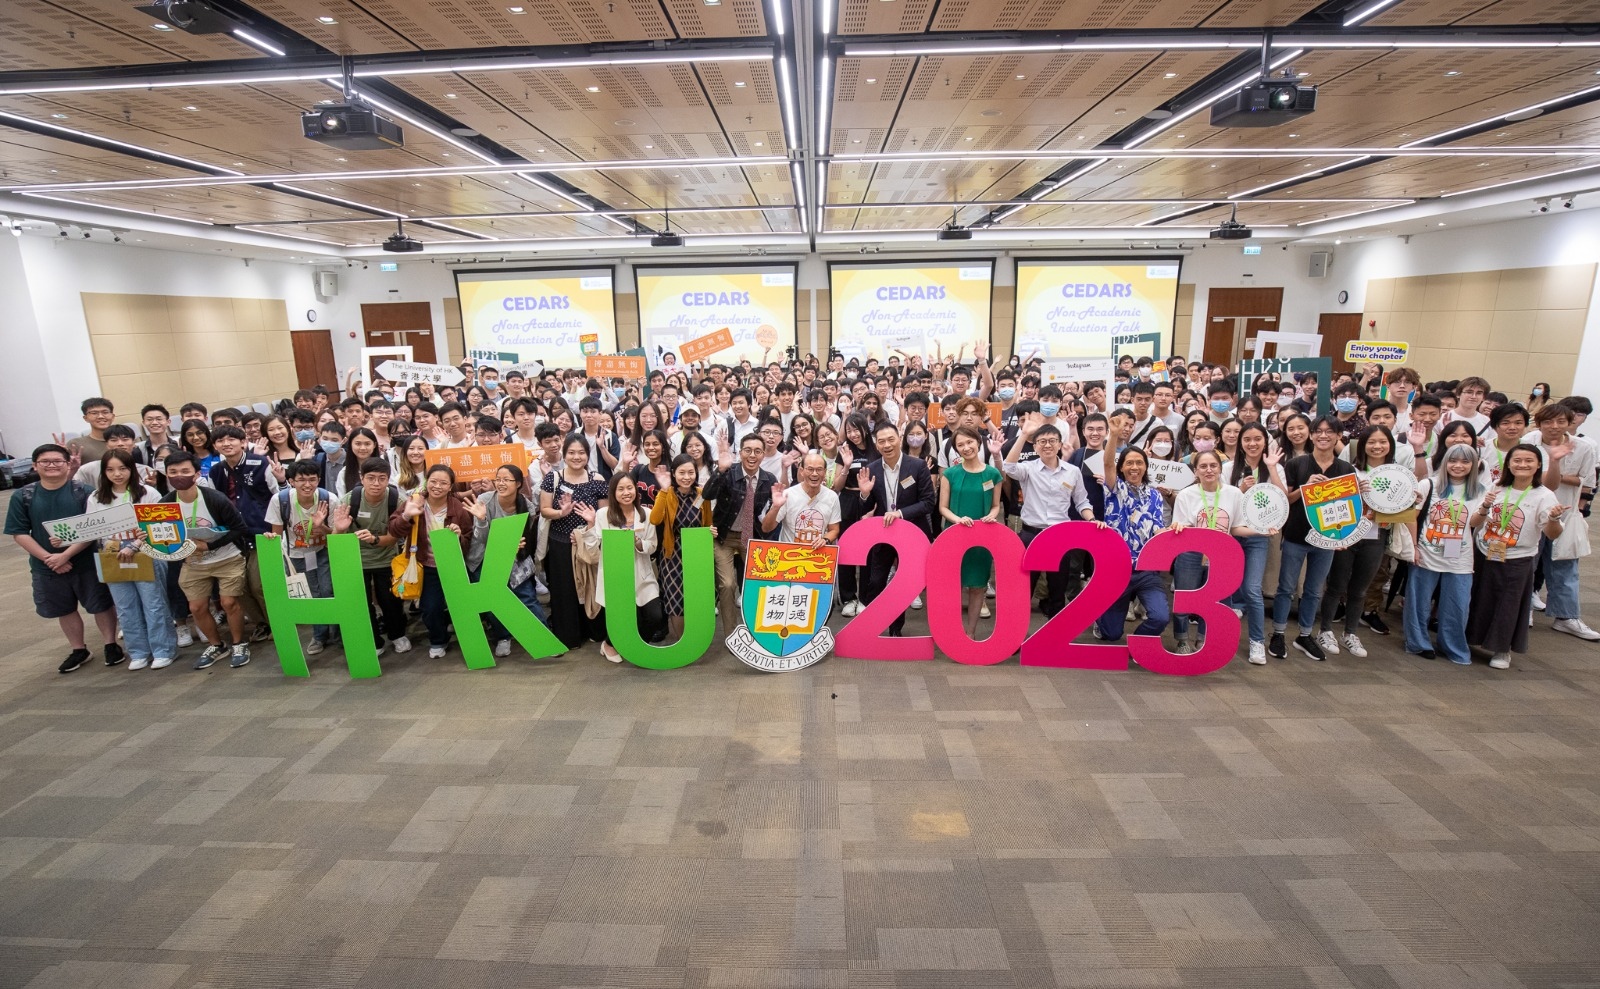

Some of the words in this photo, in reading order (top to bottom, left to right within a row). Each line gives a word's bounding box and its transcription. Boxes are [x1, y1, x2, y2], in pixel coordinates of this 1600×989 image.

[876, 285, 946, 300] CEDARS
[1062, 283, 1132, 298] CEDARS
[503, 295, 570, 311] CEDARS
[682, 291, 750, 306] CEDARS
[669, 313, 761, 328] Non-Academic
[862, 308, 957, 323] Non-Academic
[1046, 306, 1142, 320] Non-Academic
[491, 318, 583, 333] Non-Academic
[866, 324, 924, 336] Induction
[927, 323, 958, 337] Talk
[1050, 321, 1108, 333] Induction
[1110, 321, 1142, 335] Talk
[497, 334, 552, 345] Induction
[555, 332, 580, 347] Tal
[734, 328, 758, 343] Tal
[1350, 344, 1375, 353] Enjoy
[1368, 352, 1404, 360] chapter
[391, 362, 402, 370] The
[405, 364, 435, 375] University
[400, 371, 442, 383] 香港大學
[1161, 463, 1170, 471] of
[1171, 465, 1183, 473] HK
[255, 512, 716, 679] HKU
[834, 516, 1246, 676] 2023
